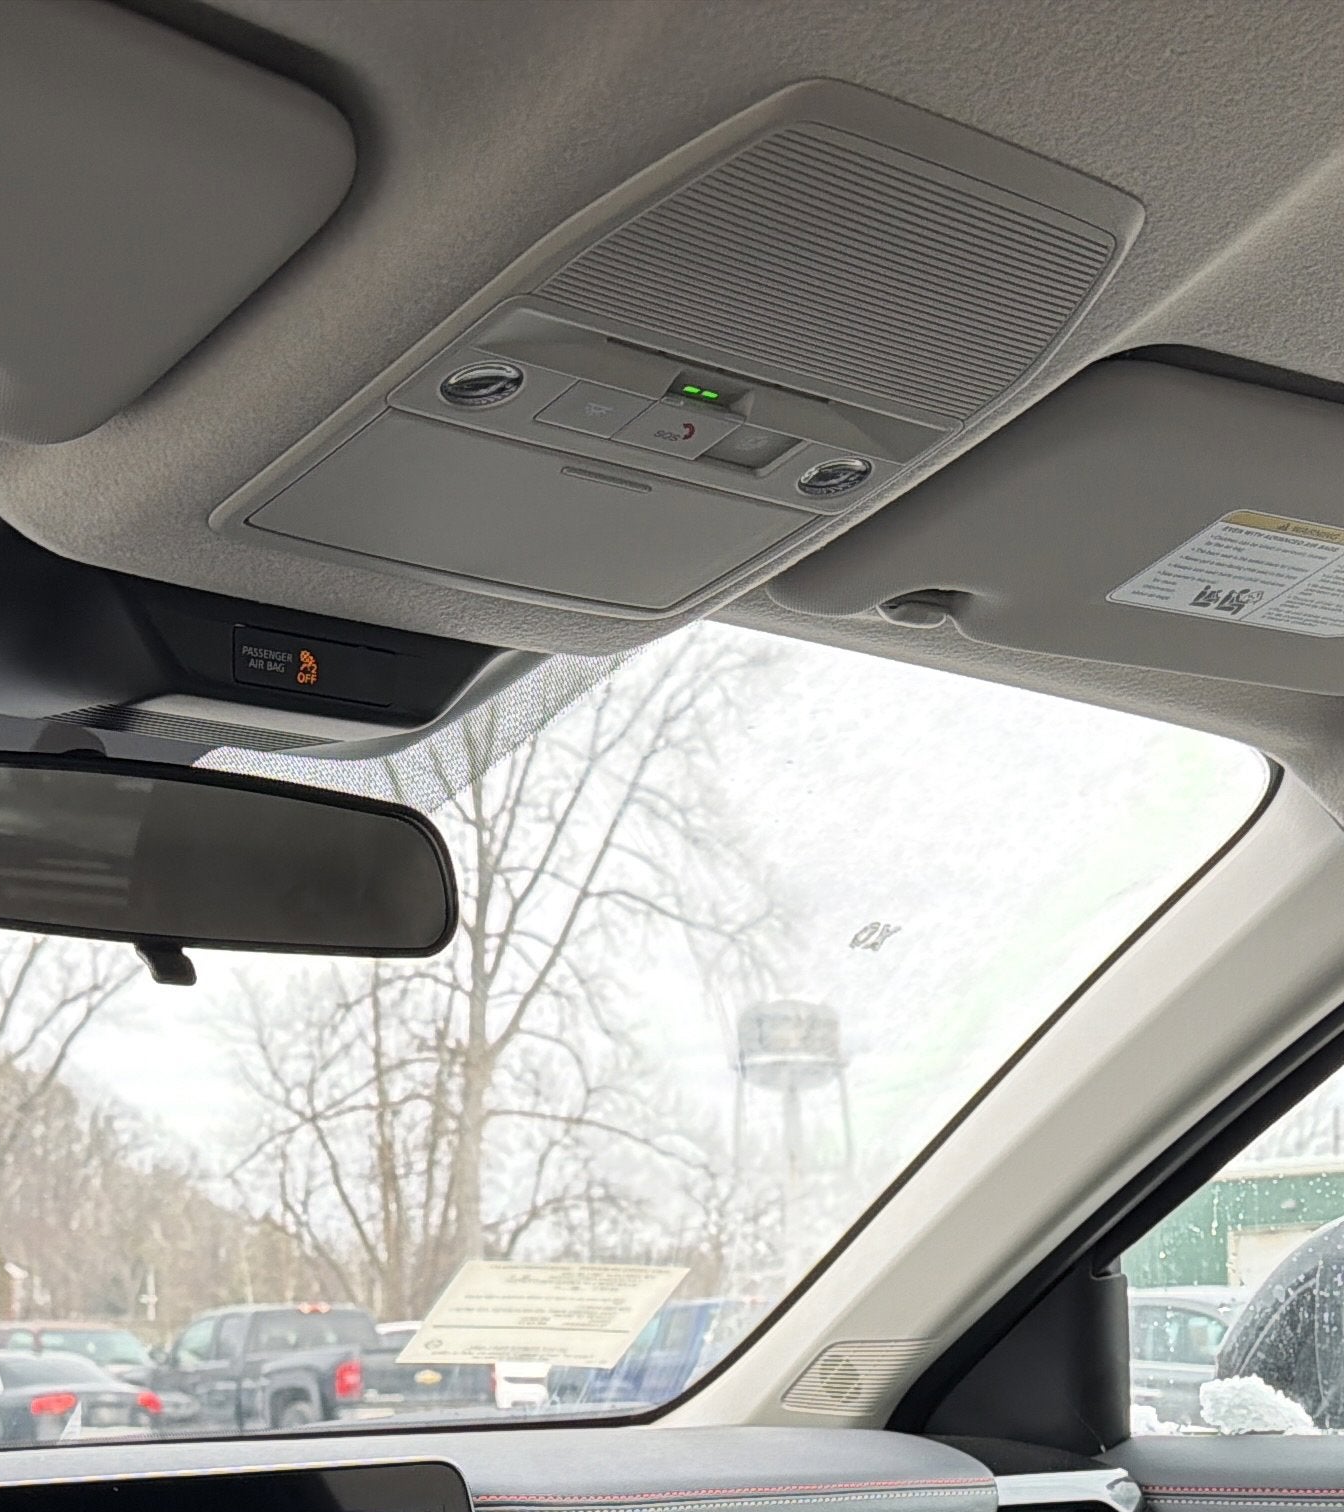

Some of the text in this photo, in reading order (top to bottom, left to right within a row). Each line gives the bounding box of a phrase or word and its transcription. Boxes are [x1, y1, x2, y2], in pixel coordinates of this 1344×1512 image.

[241, 645, 294, 663] PASSENGER
[248, 658, 286, 673] AIR BAG
[296, 672, 318, 685] OFF
